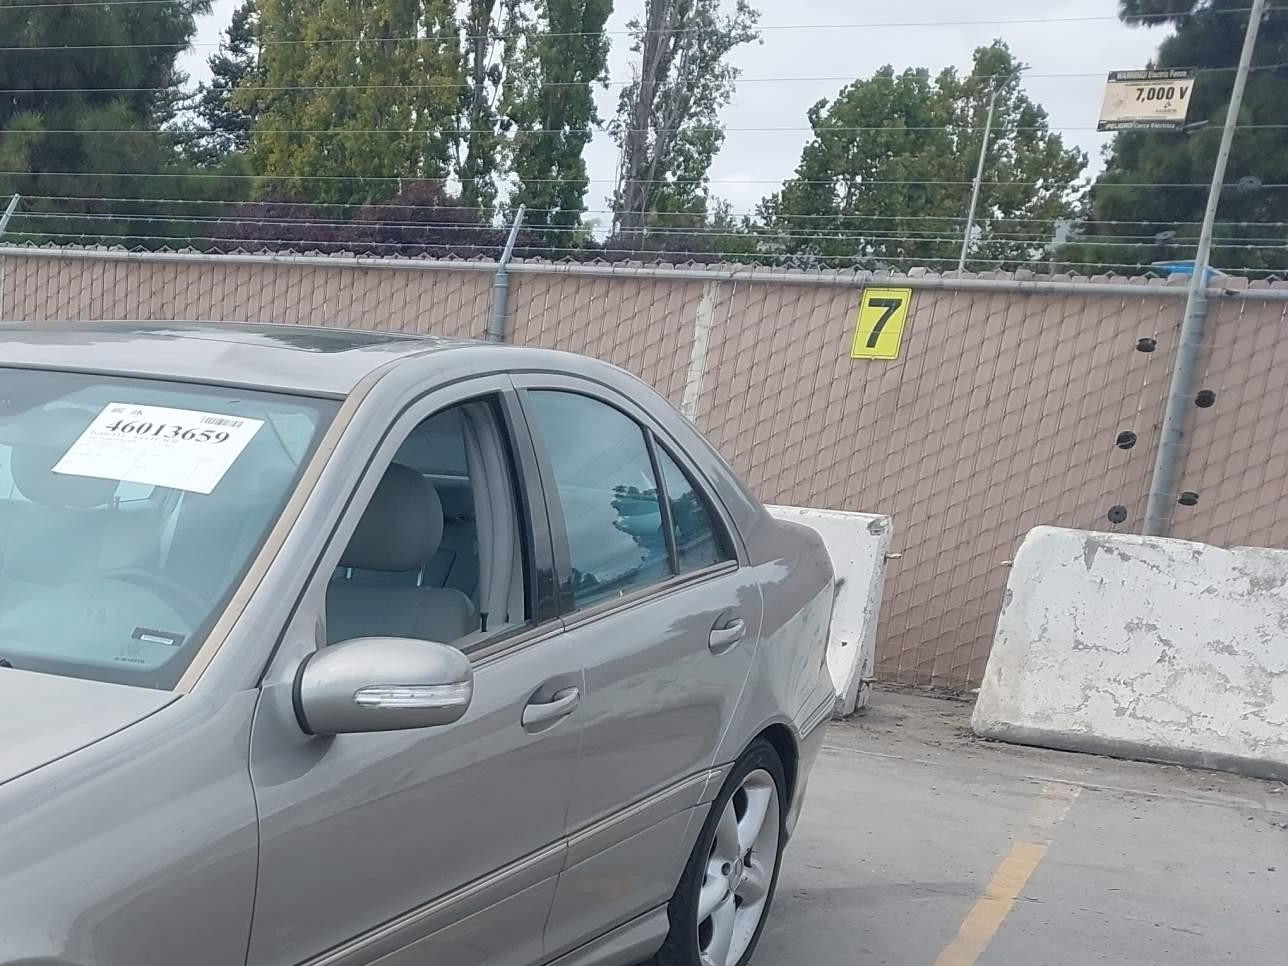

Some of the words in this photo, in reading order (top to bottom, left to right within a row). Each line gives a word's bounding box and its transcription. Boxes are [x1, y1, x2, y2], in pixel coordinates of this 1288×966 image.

[1136, 86, 1175, 102] 7,000
[1179, 86, 1189, 99] V
[866, 298, 903, 348] 7
[105, 419, 230, 444] 46013659
